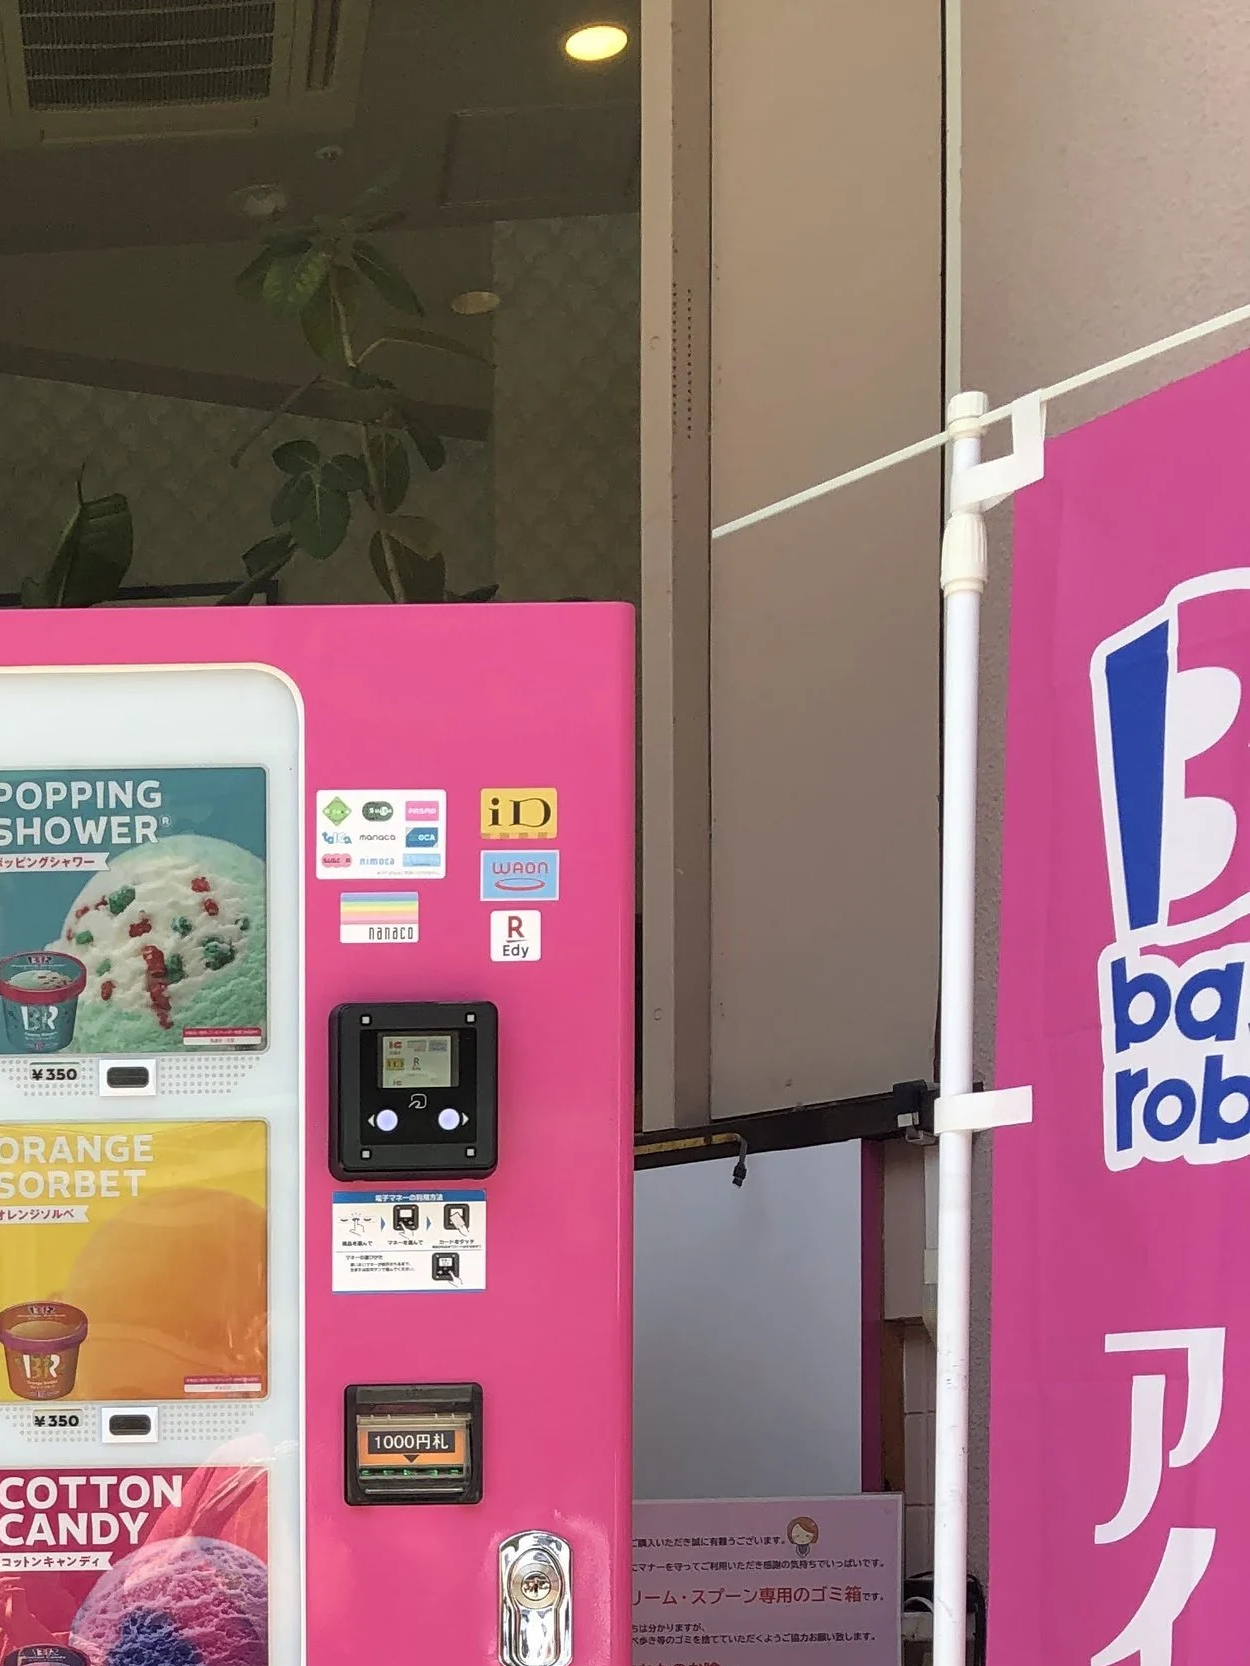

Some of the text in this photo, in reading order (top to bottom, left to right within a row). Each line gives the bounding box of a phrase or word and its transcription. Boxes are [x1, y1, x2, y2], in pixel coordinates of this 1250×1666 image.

[488, 797, 551, 827] iD
[359, 857, 395, 866] nimoca
[368, 926, 414, 940] nanaco
[508, 916, 525, 938] R
[503, 945, 529, 958] Edy
[1111, 956, 1250, 1054] ba
[32, 1067, 77, 1081] ¥350
[34, 1415, 79, 1428] ¥350
[374, 1433, 449, 1450] 1000円札
[1, 1555, 100, 1568] コットンキャンディ
